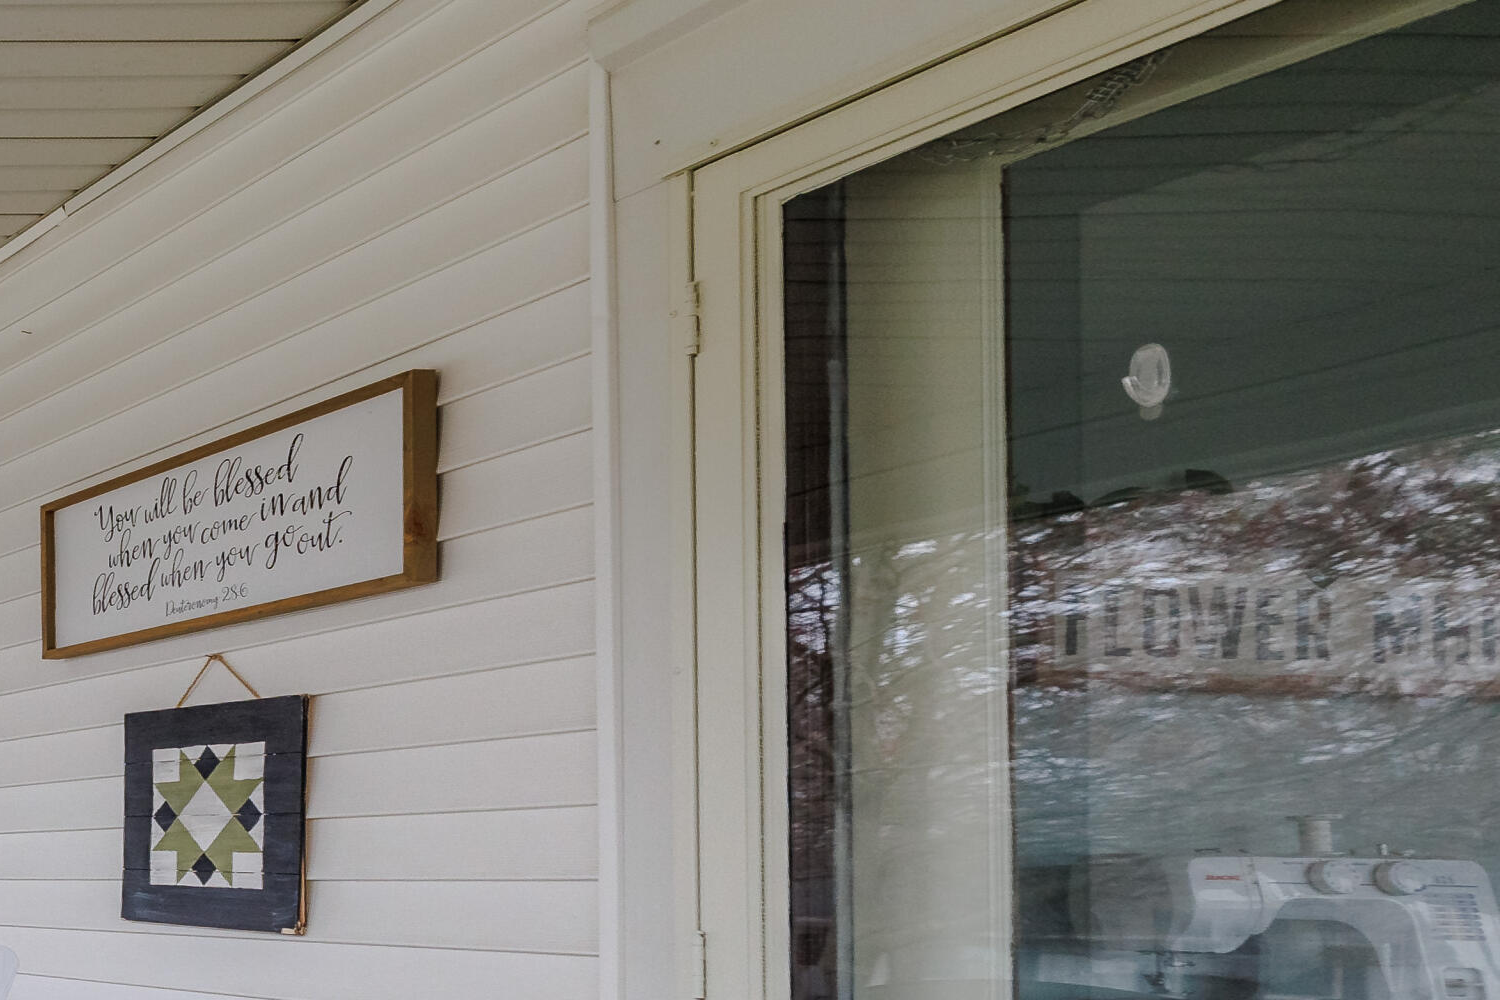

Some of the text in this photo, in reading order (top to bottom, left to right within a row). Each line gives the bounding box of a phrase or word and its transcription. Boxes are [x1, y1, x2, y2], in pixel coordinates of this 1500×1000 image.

[94, 433, 304, 542] You will be blessed
[108, 455, 353, 568] when you come in and
[92, 510, 353, 615] blessed when you go out.
